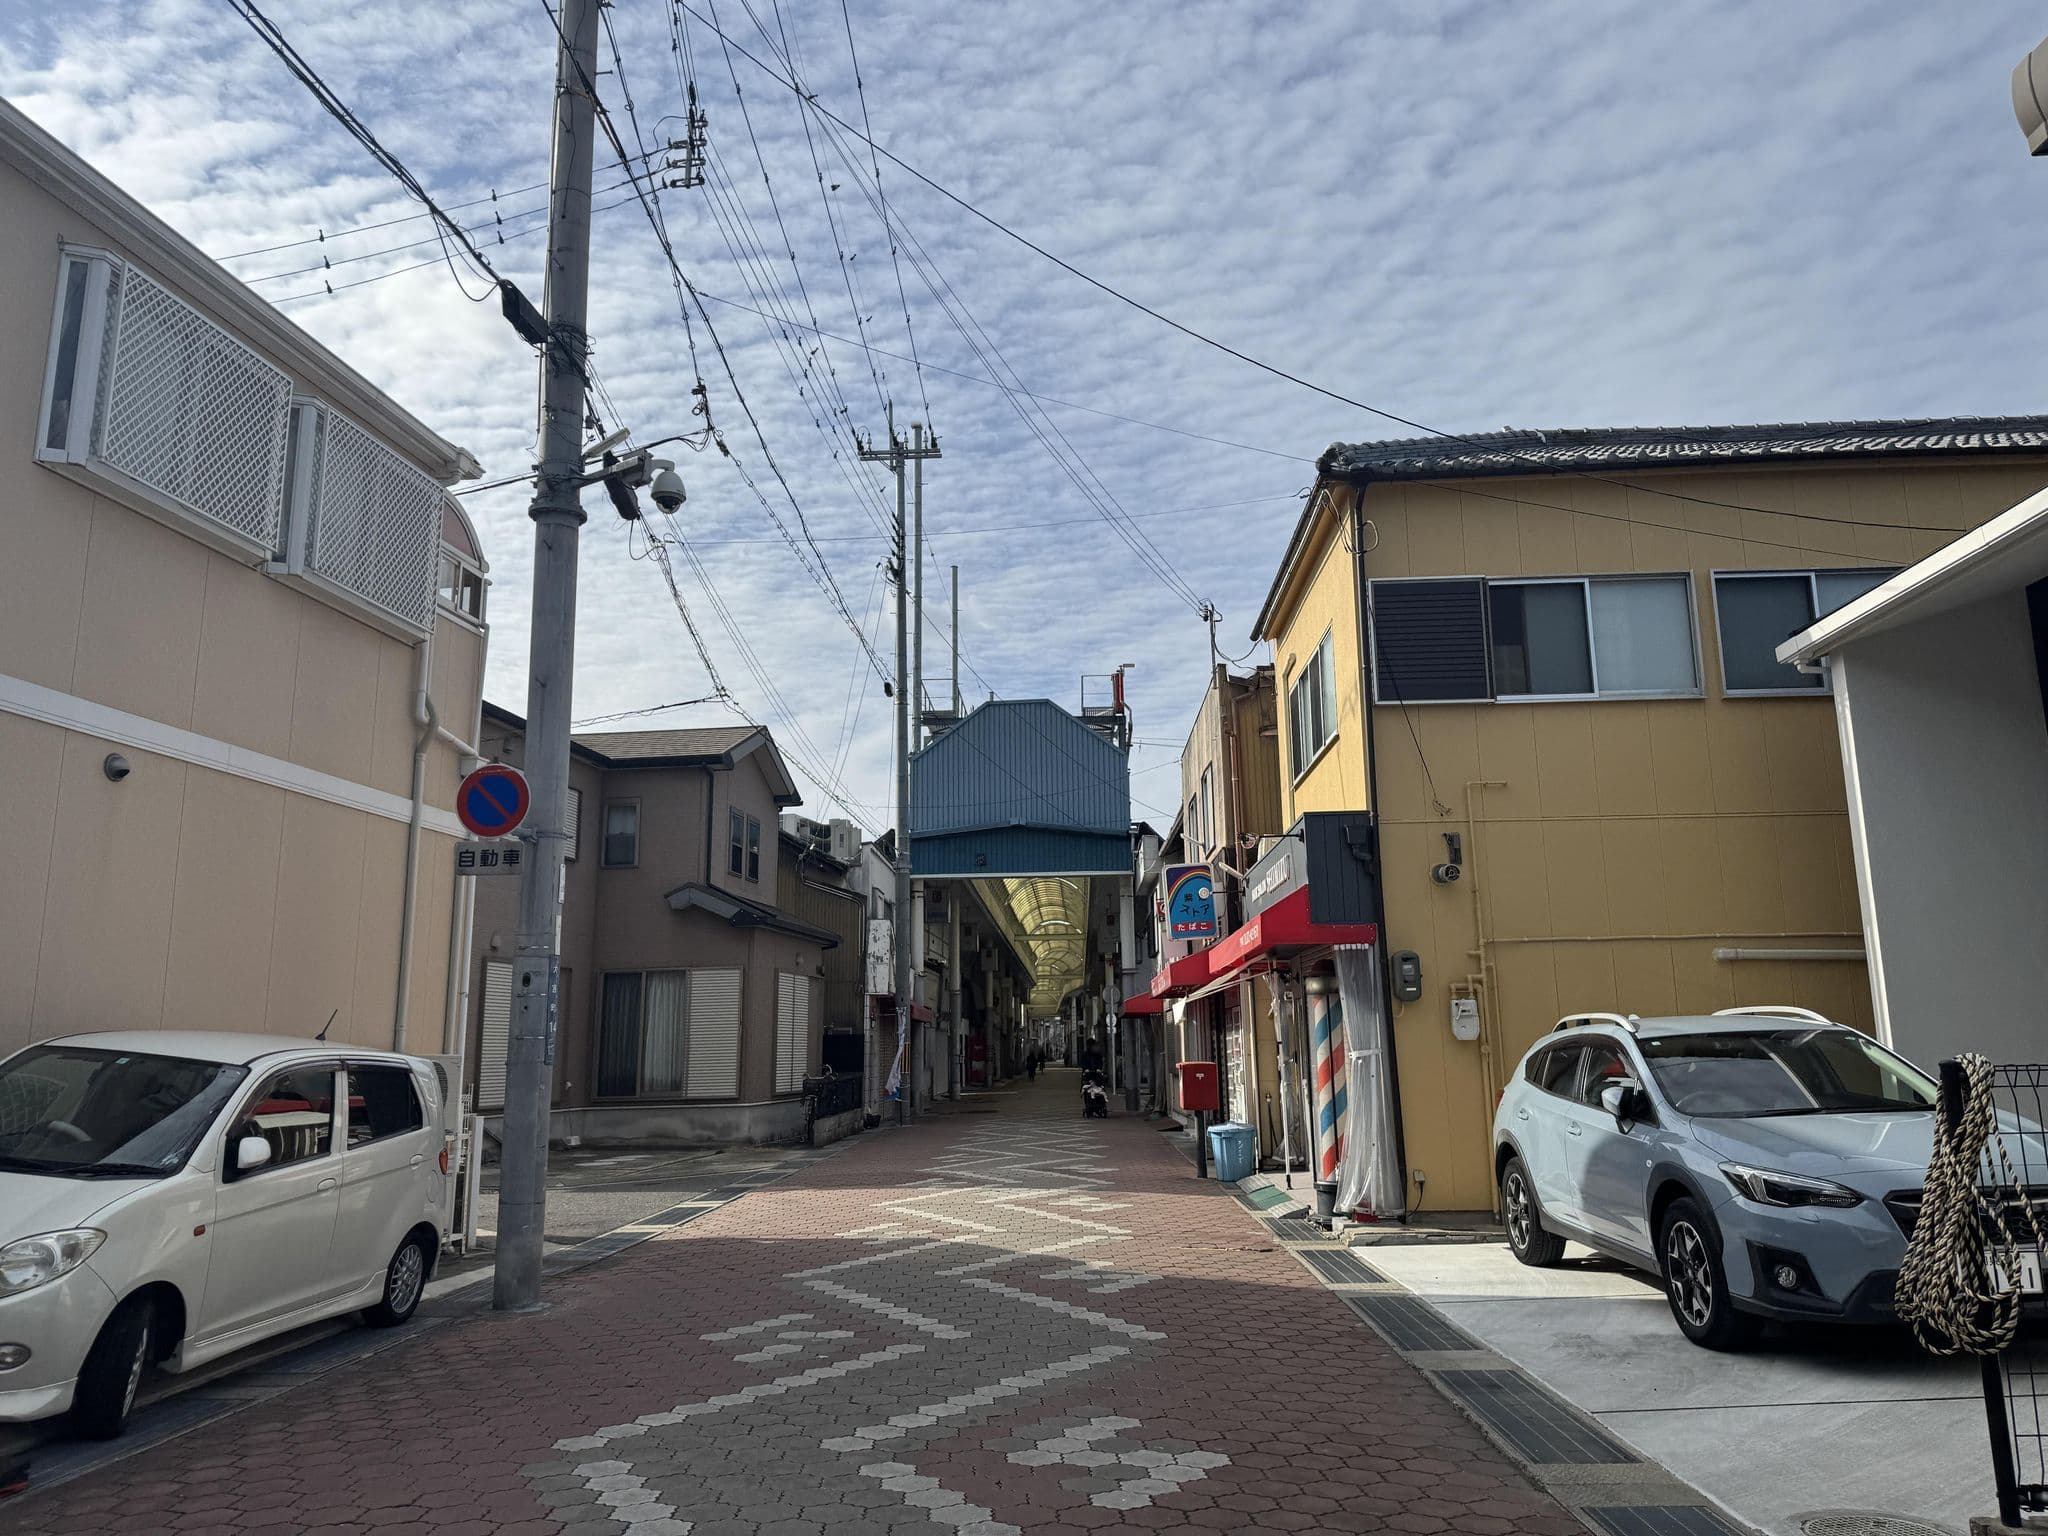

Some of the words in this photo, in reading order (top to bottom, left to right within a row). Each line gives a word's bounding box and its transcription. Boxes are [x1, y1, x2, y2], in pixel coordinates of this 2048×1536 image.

[458, 848, 520, 868] 自動車
[1179, 903, 1210, 918] ストア
[1177, 922, 1209, 932] たばこ
